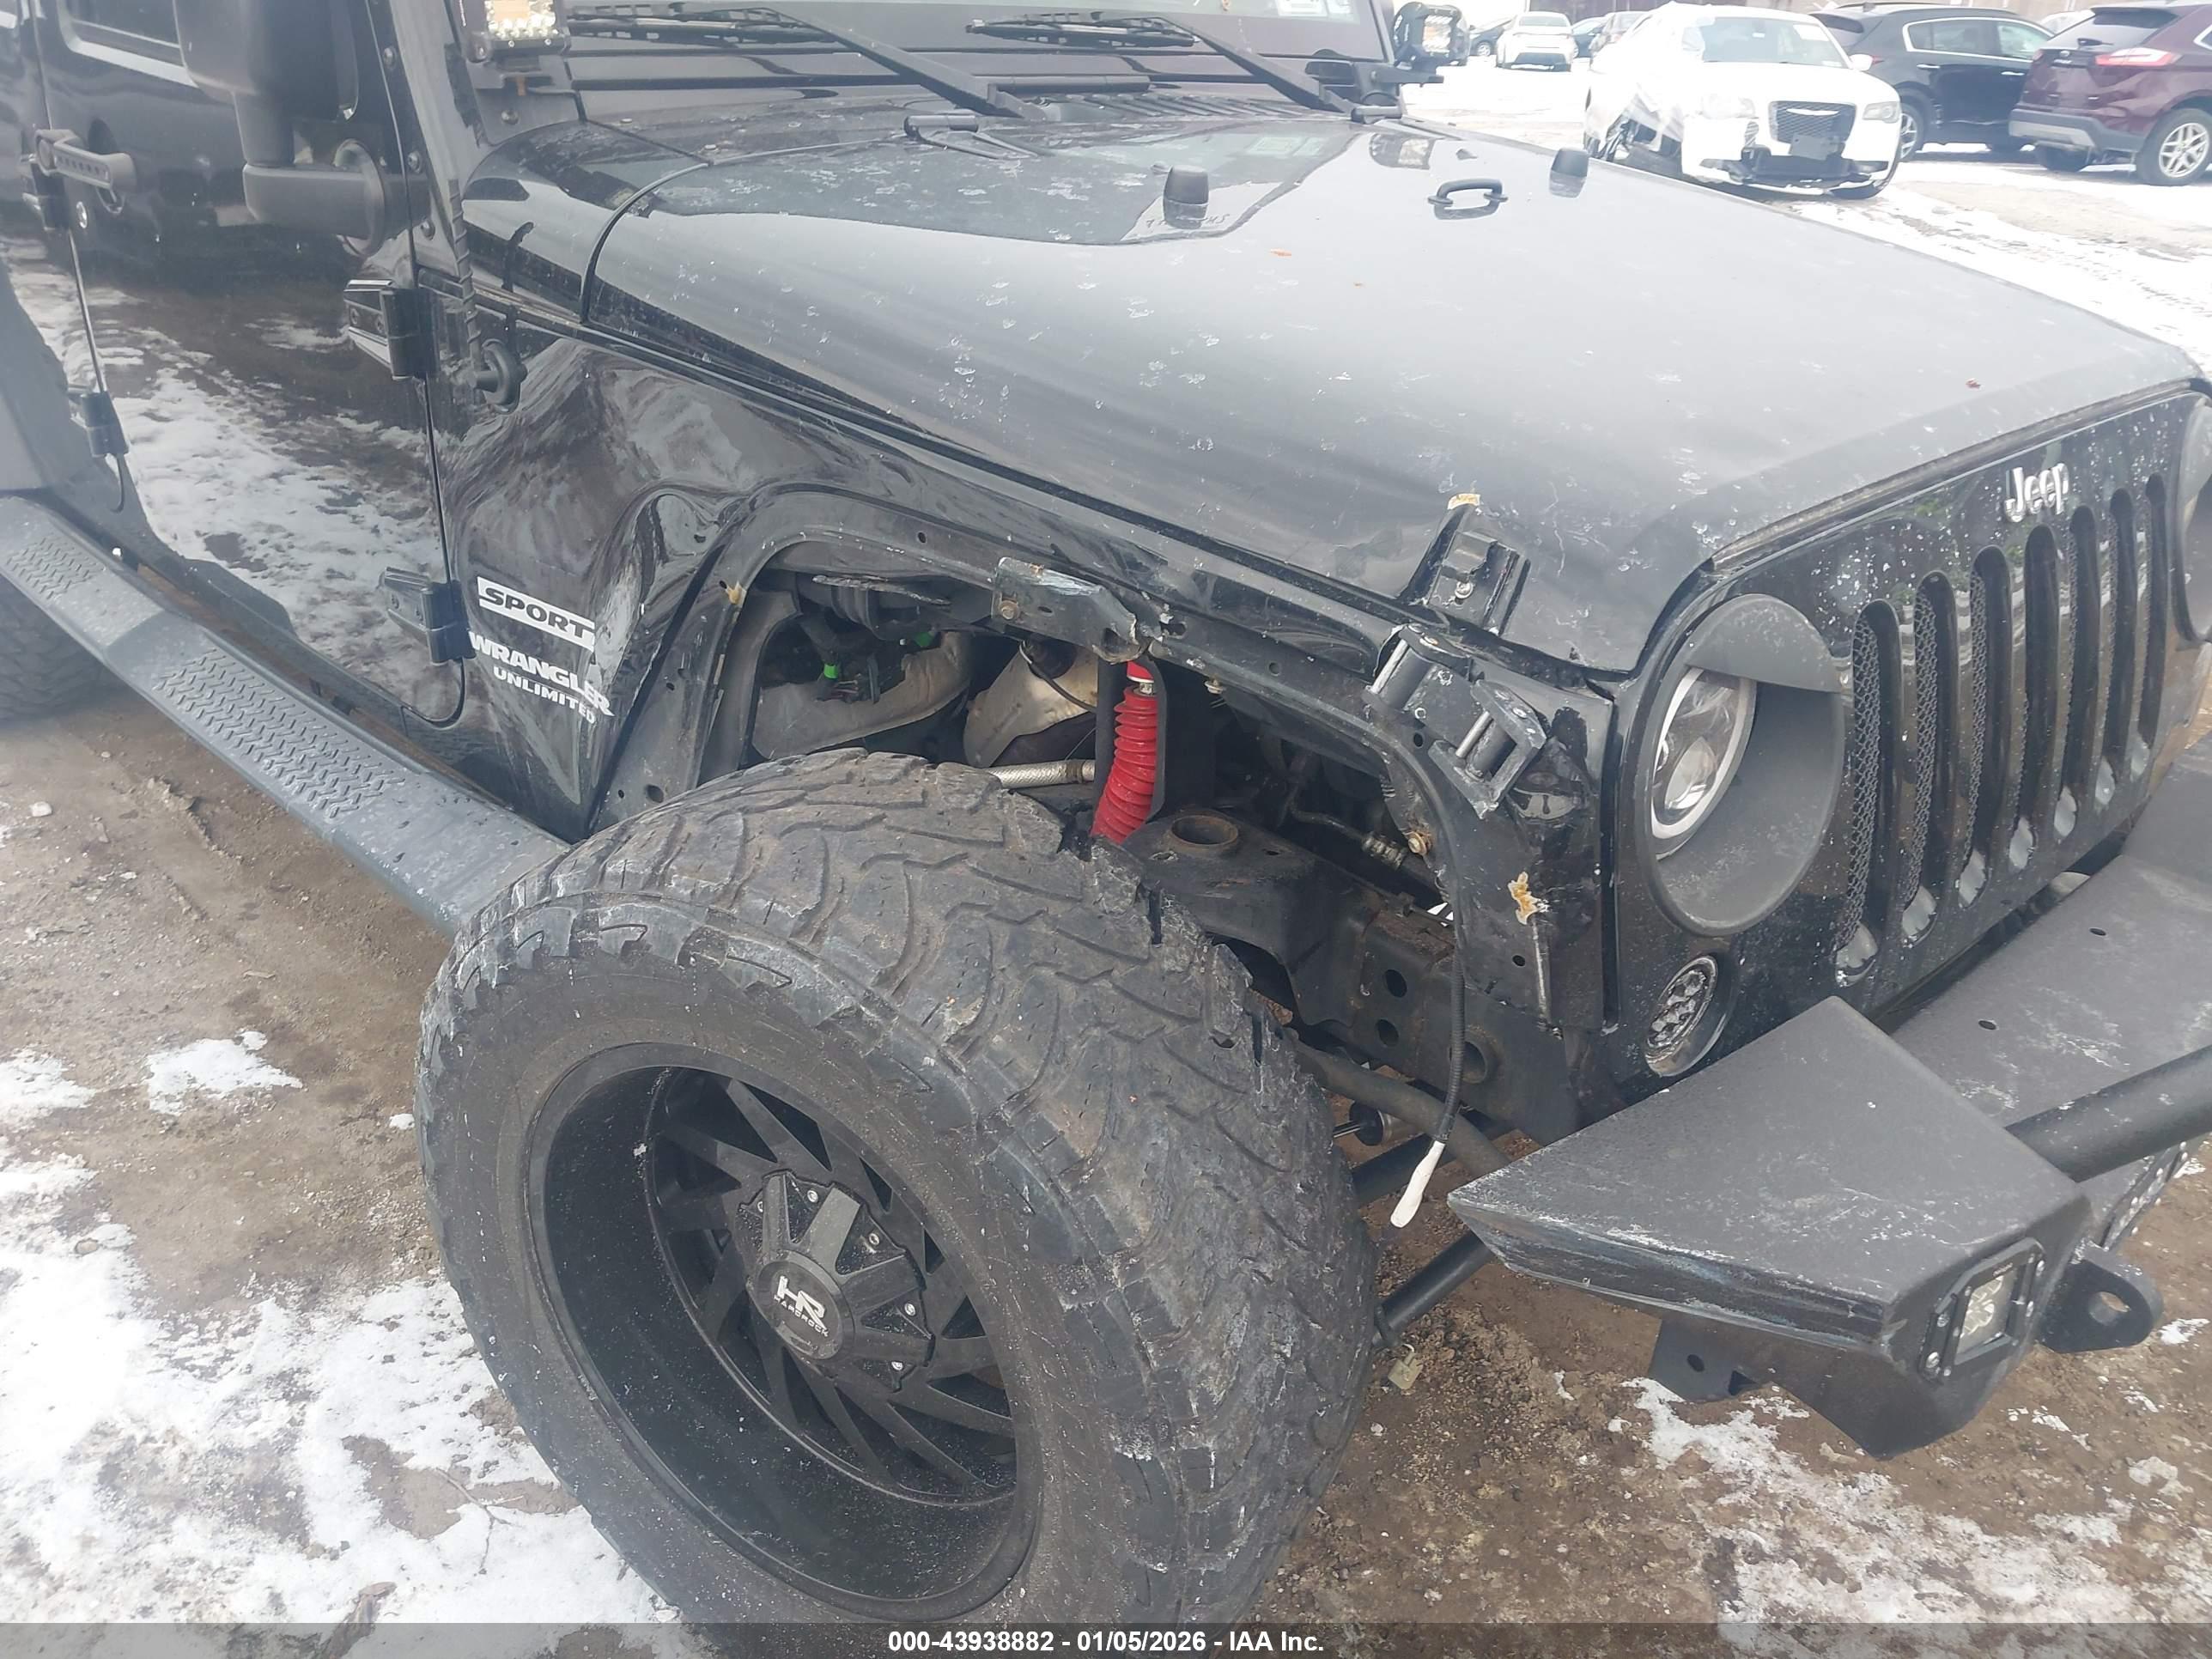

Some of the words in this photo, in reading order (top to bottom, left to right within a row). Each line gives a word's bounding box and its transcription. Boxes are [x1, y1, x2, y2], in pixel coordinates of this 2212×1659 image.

[2005, 463, 2069, 523] Jeep
[479, 586, 595, 641] SPORT
[469, 629, 615, 717] WRANGLER
[493, 665, 597, 725] UNLIMITED
[774, 1294, 829, 1337] HARDROCK
